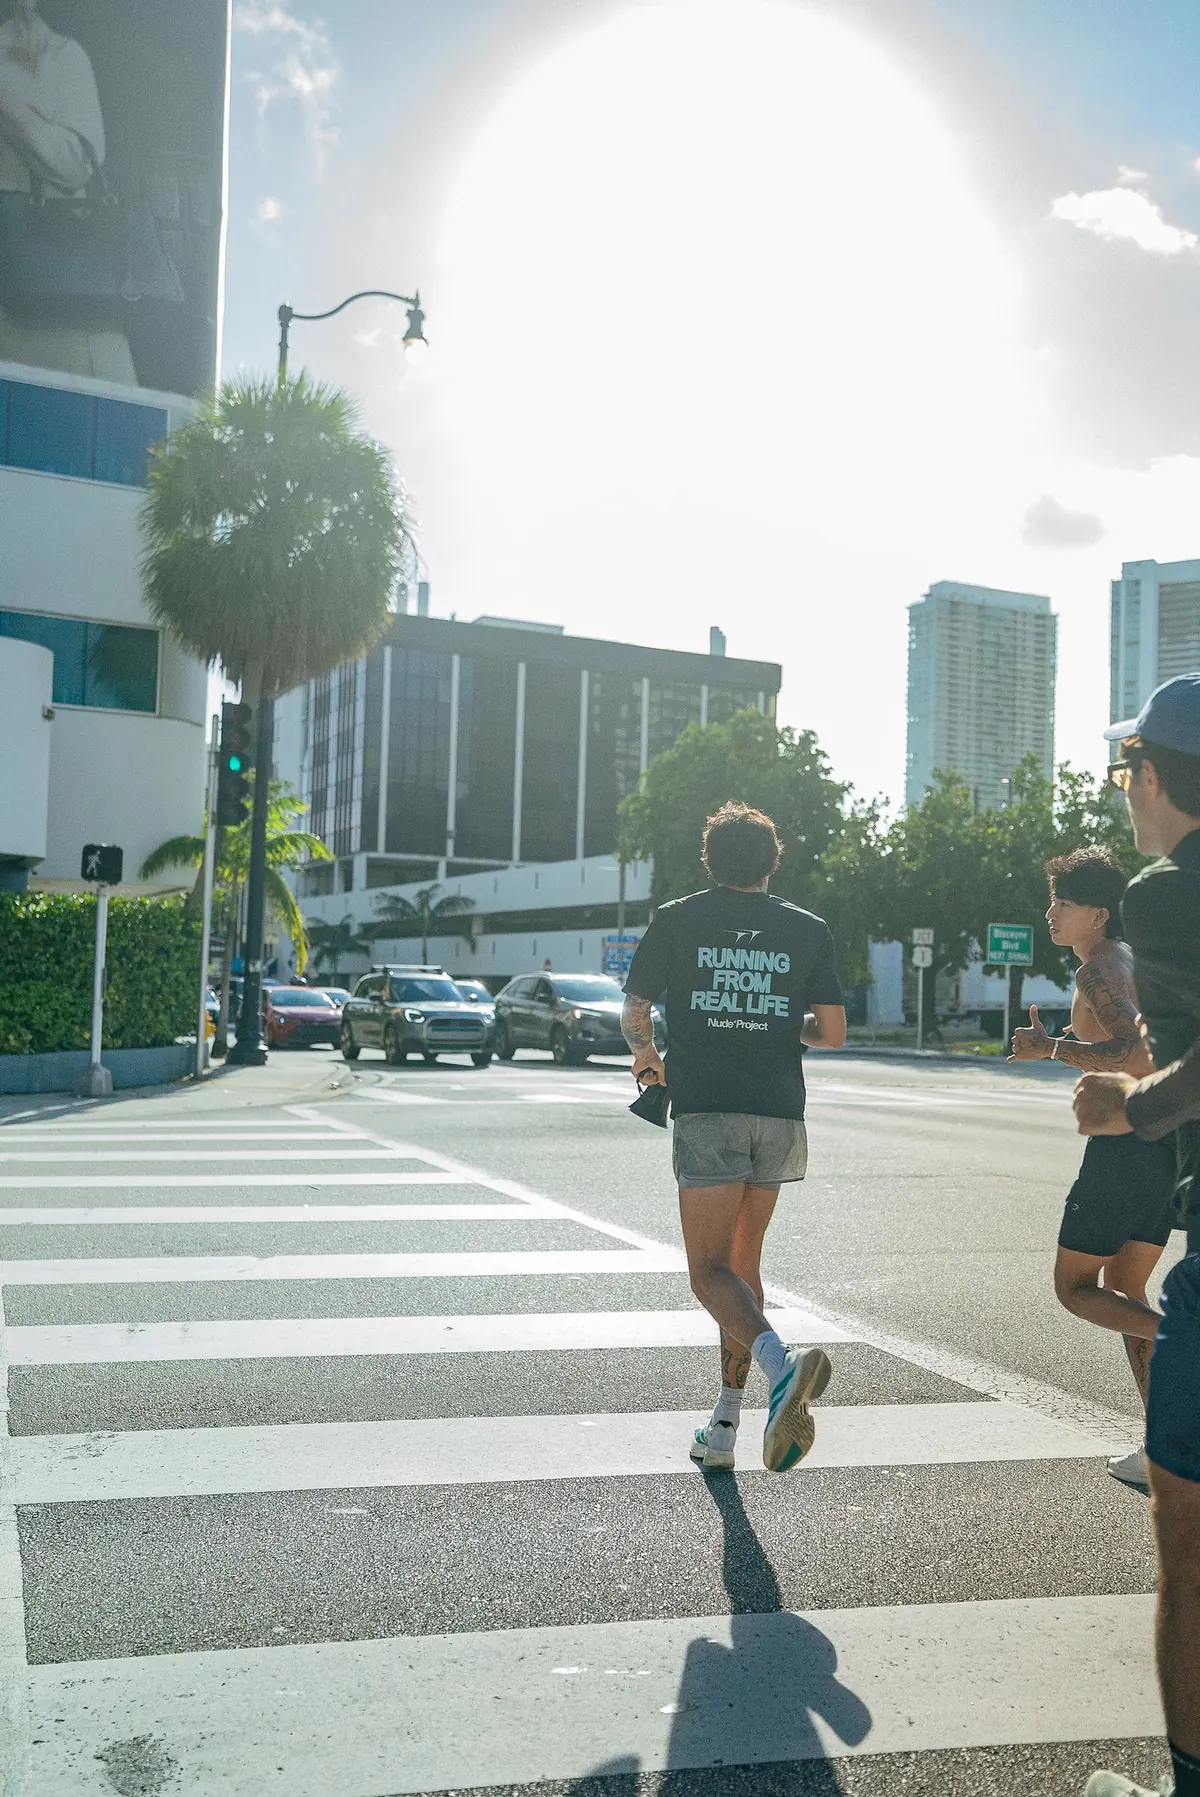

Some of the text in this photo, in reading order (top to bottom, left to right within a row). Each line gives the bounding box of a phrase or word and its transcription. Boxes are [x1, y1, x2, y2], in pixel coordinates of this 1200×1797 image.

[993, 928, 1028, 940] Biscayne
[697, 946, 791, 973] RUNNING
[713, 969, 771, 993] FROM
[690, 991, 789, 1017] REAL LIFE
[736, 1019, 768, 1031] Project
